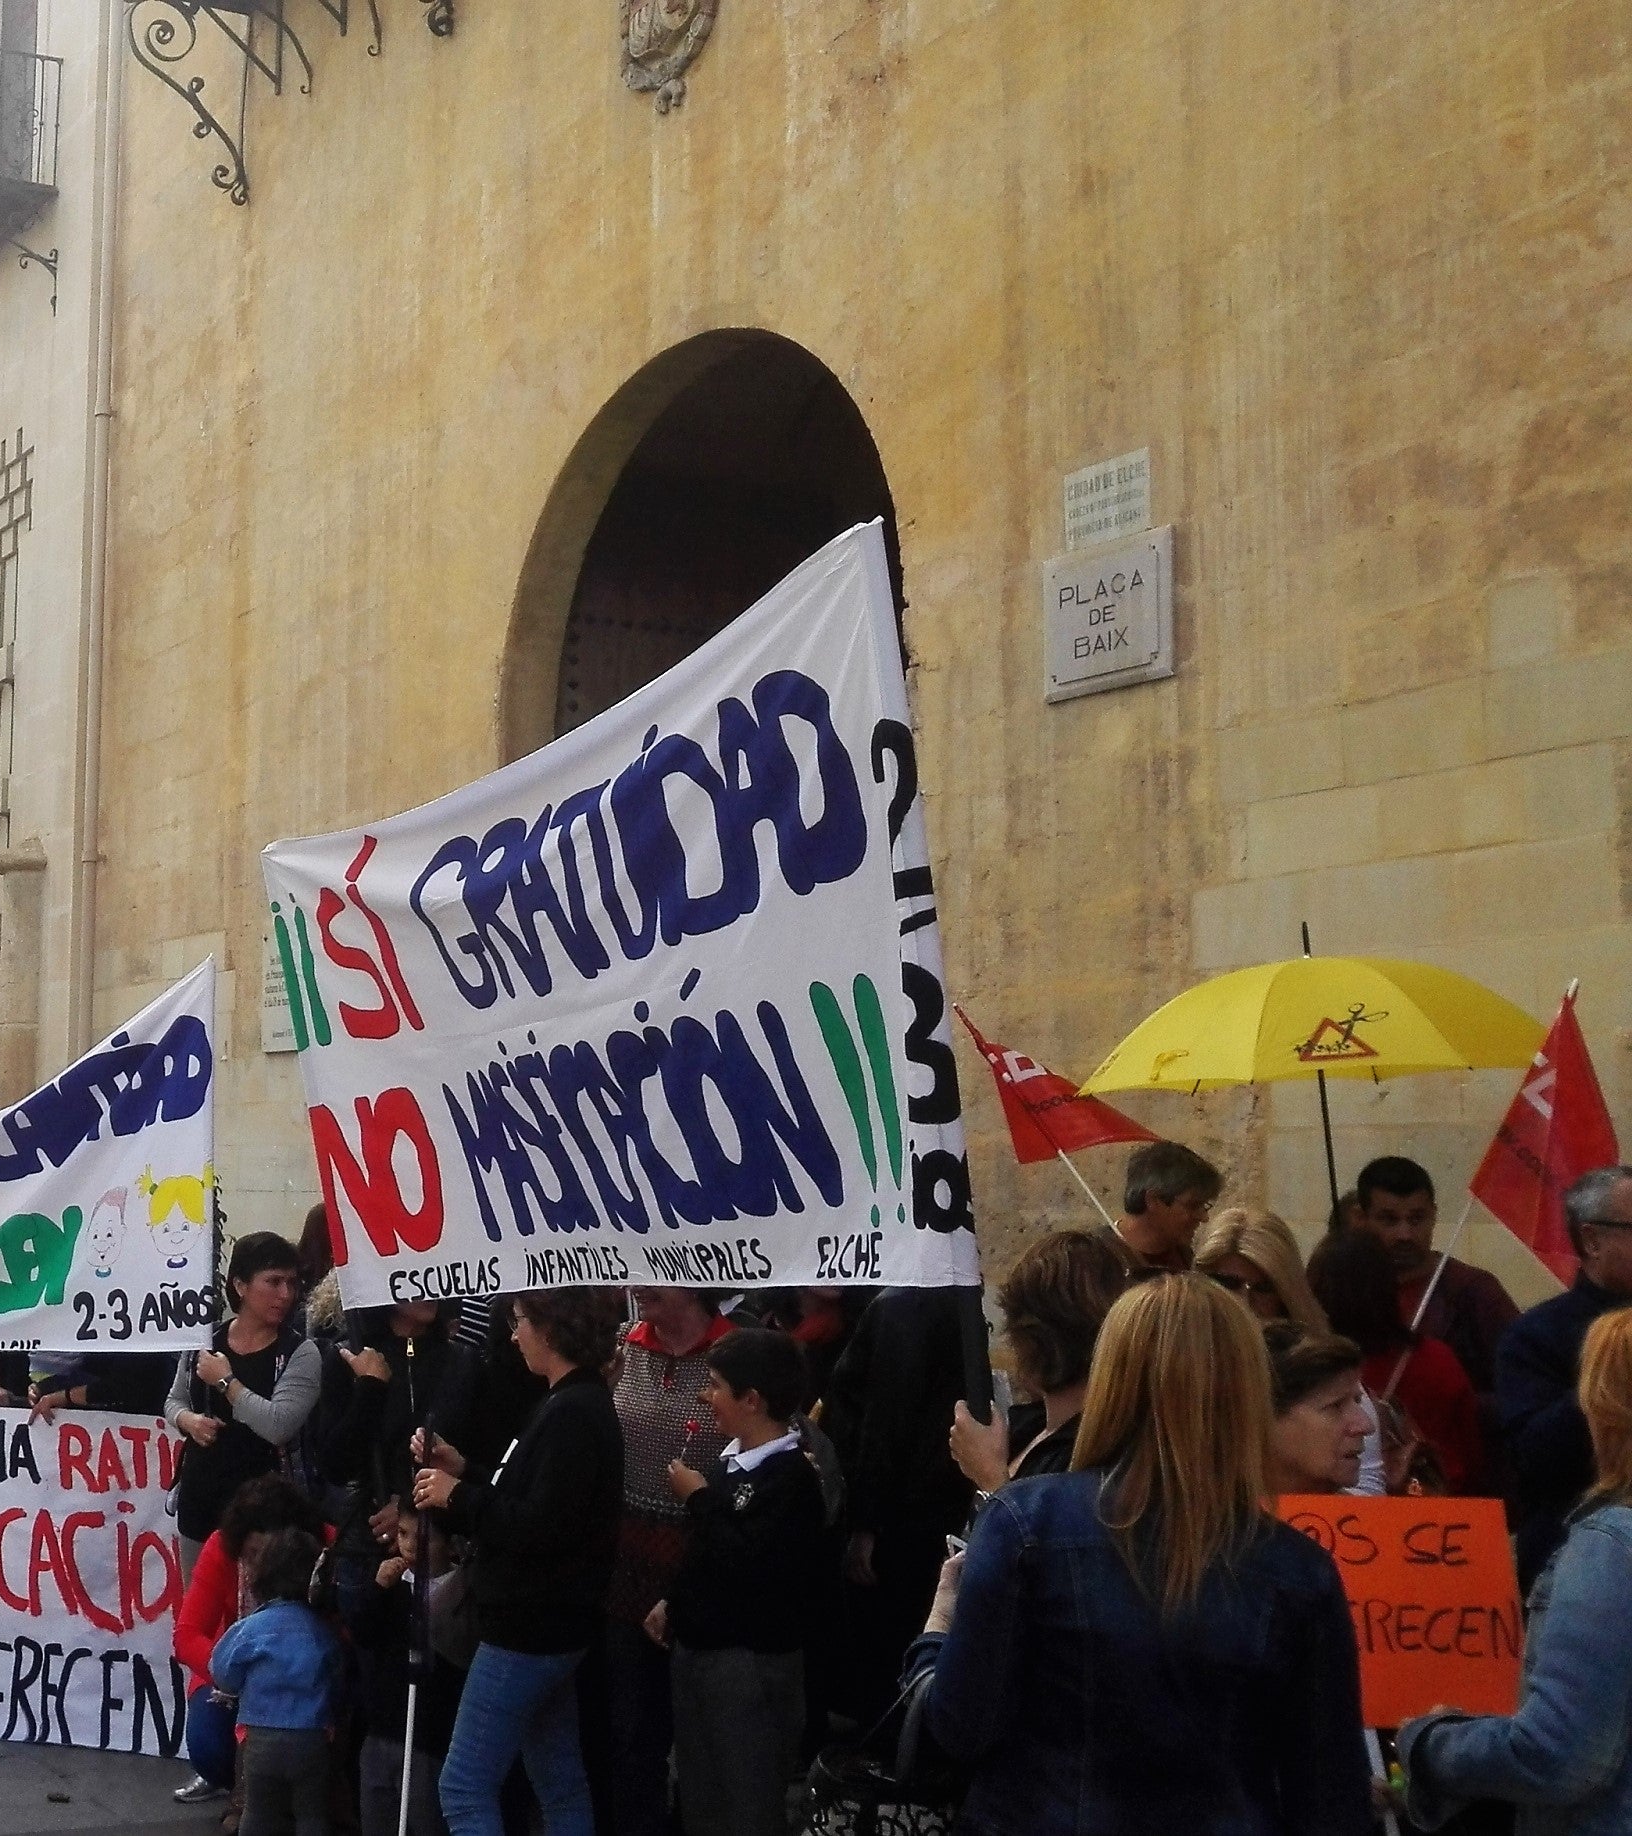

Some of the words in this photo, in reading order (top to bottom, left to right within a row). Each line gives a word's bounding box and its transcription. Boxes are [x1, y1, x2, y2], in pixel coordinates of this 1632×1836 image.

[1088, 603, 1116, 626] DE
[1074, 625, 1129, 660] BAIX
[308, 1086, 445, 1268] NO
[388, 1256, 501, 1302] ESCUELAS
[815, 1231, 884, 1280] ELCHE
[72, 1288, 133, 1342] 2-3
[138, 1281, 217, 1334] AÑOS
[1402, 1521, 1471, 1567] SE
